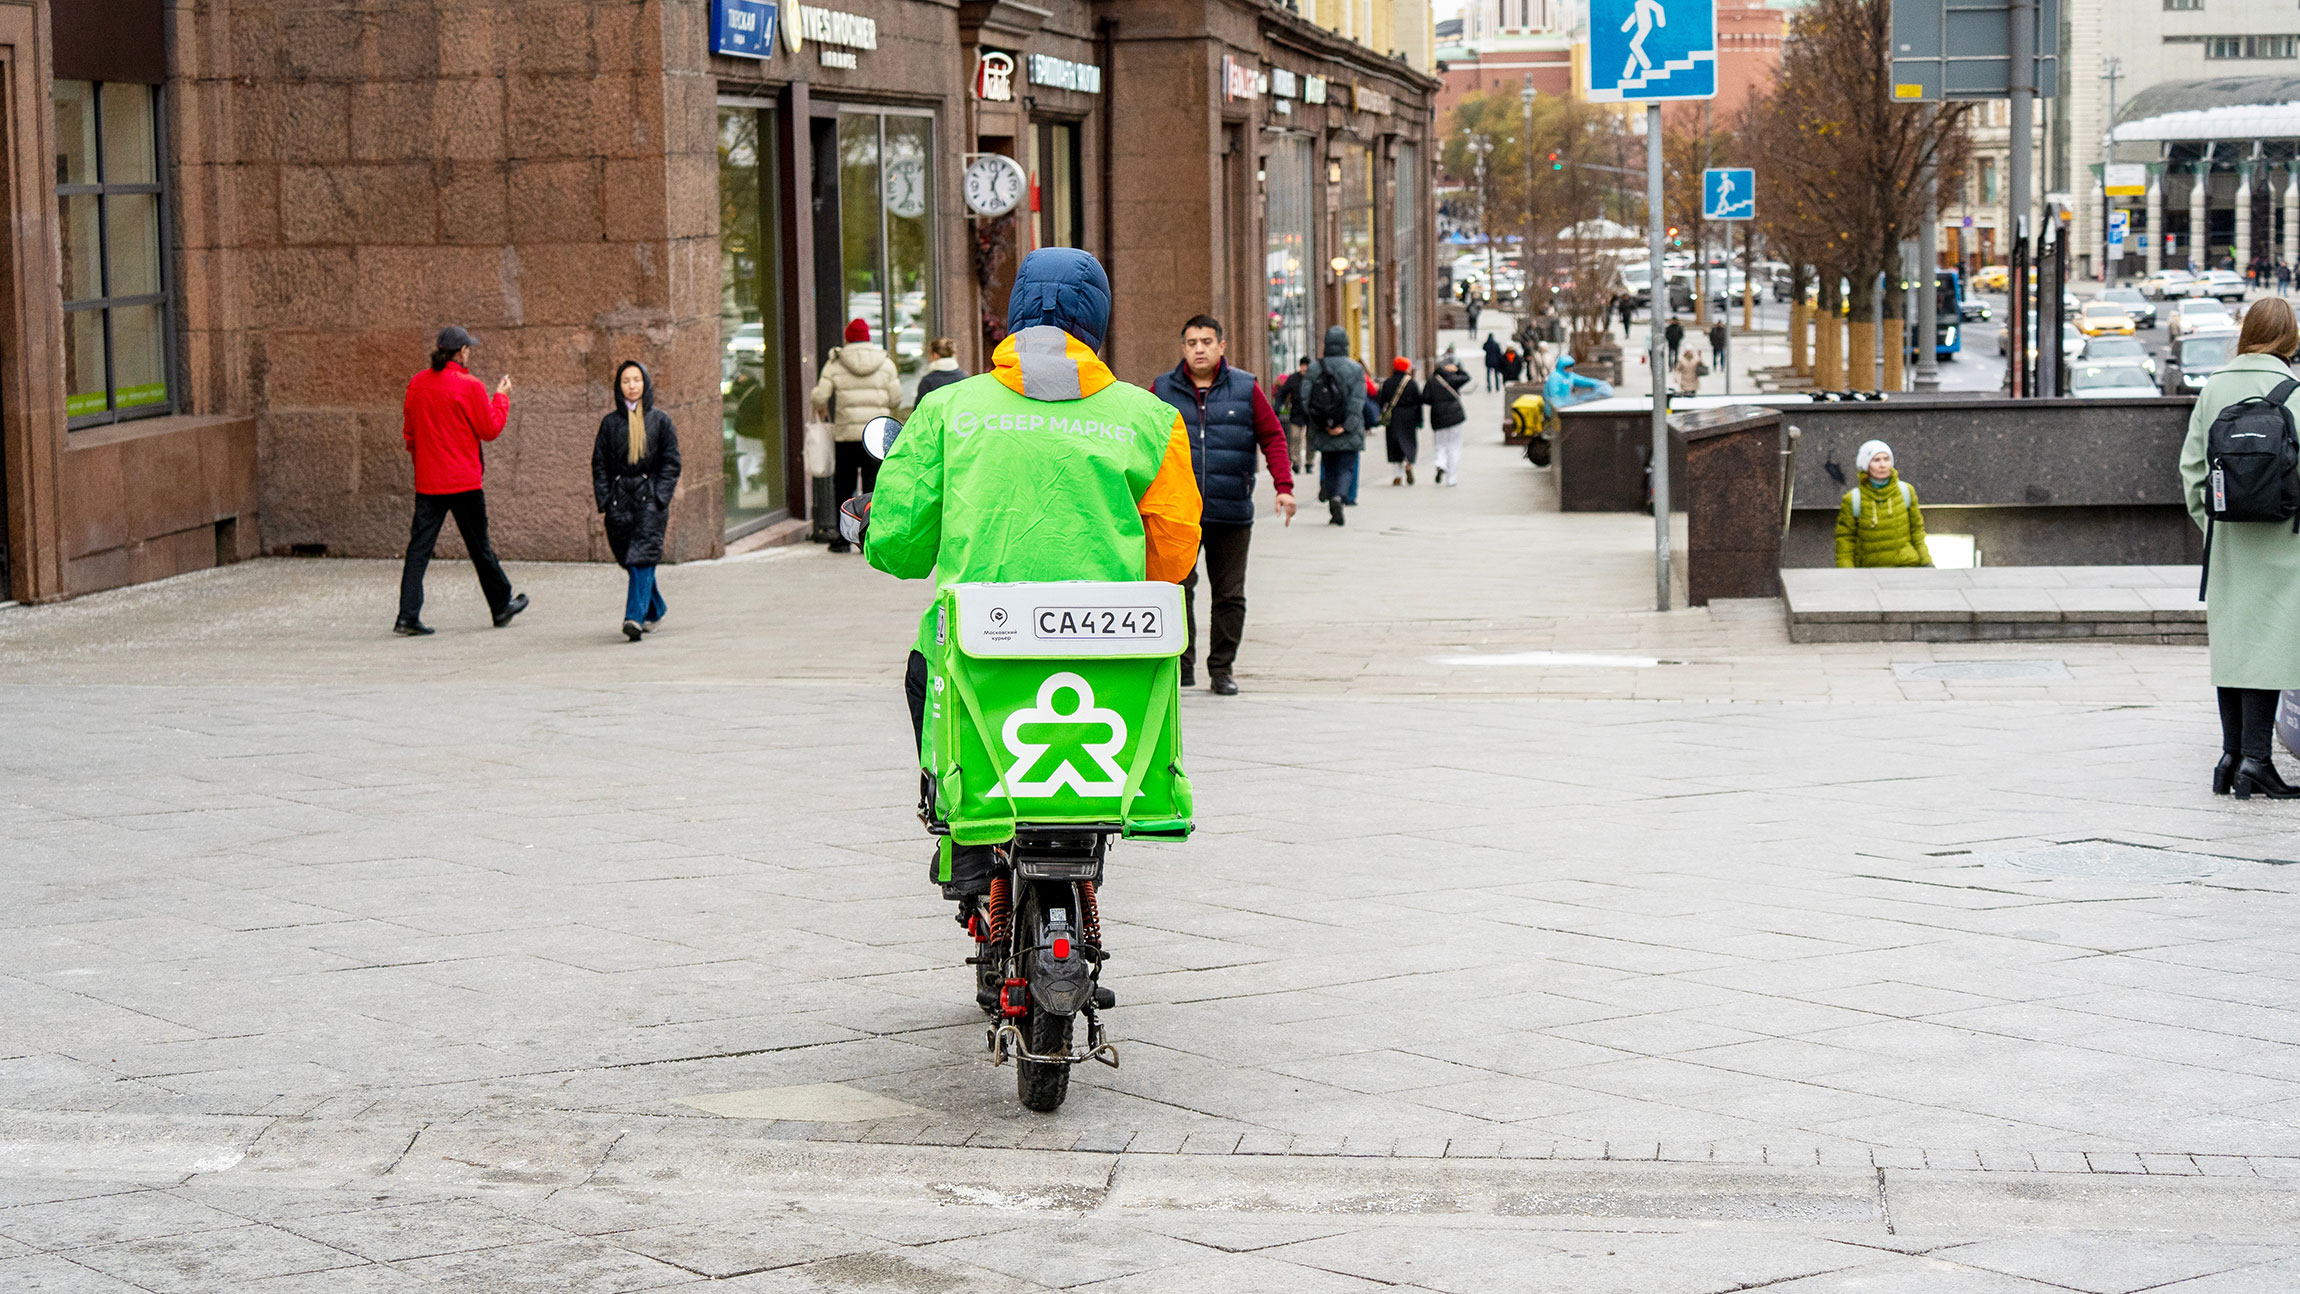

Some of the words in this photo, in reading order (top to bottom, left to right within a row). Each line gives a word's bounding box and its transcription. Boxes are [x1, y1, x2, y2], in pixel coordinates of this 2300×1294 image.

[800, 4, 831, 44] YVES
[831, 11, 877, 50] ROCHER
[984, 414, 1045, 431] СБЕР
[1049, 415, 1138, 446] МАРКЕТ
[1040, 611, 1156, 634] CA4242
